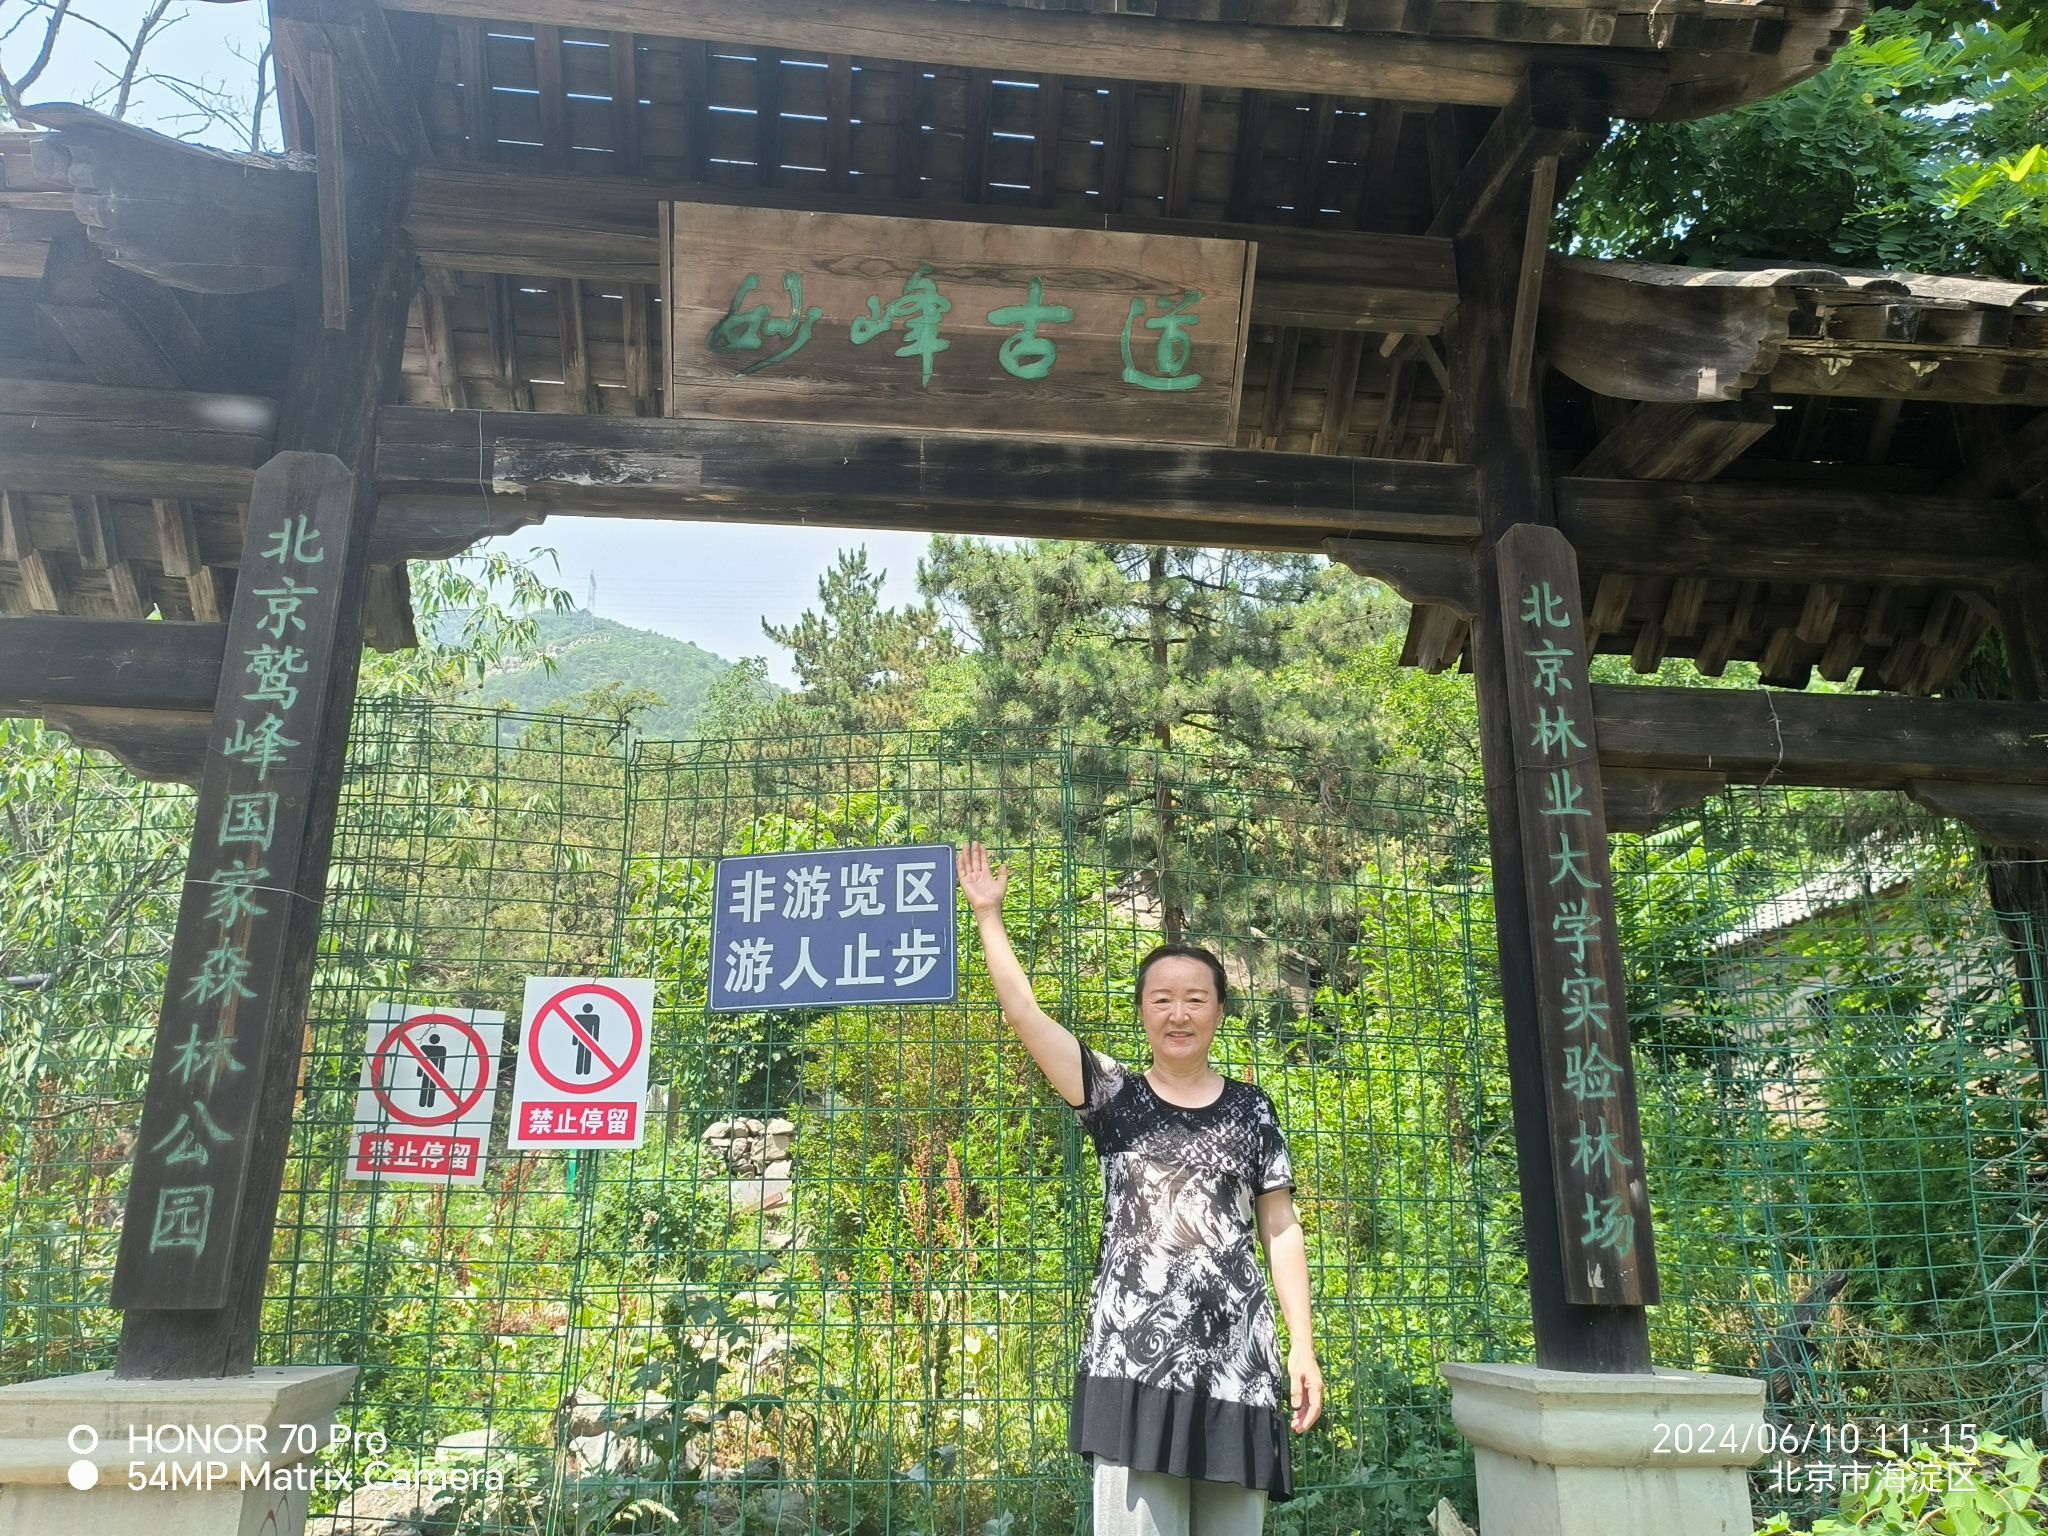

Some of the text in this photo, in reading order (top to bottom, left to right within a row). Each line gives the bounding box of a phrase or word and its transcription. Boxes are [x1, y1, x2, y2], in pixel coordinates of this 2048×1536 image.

[706, 263, 1201, 391] 妙峰古道
[149, 514, 325, 1256] 北京鹫峰国家森林公园
[729, 861, 939, 924] 非游览区
[1520, 581, 1636, 1258] 北京林业大学实验林场
[724, 928, 941, 994] 游人止步
[528, 1107, 631, 1136] 禁止停留
[367, 1138, 472, 1173] 禁止停留
